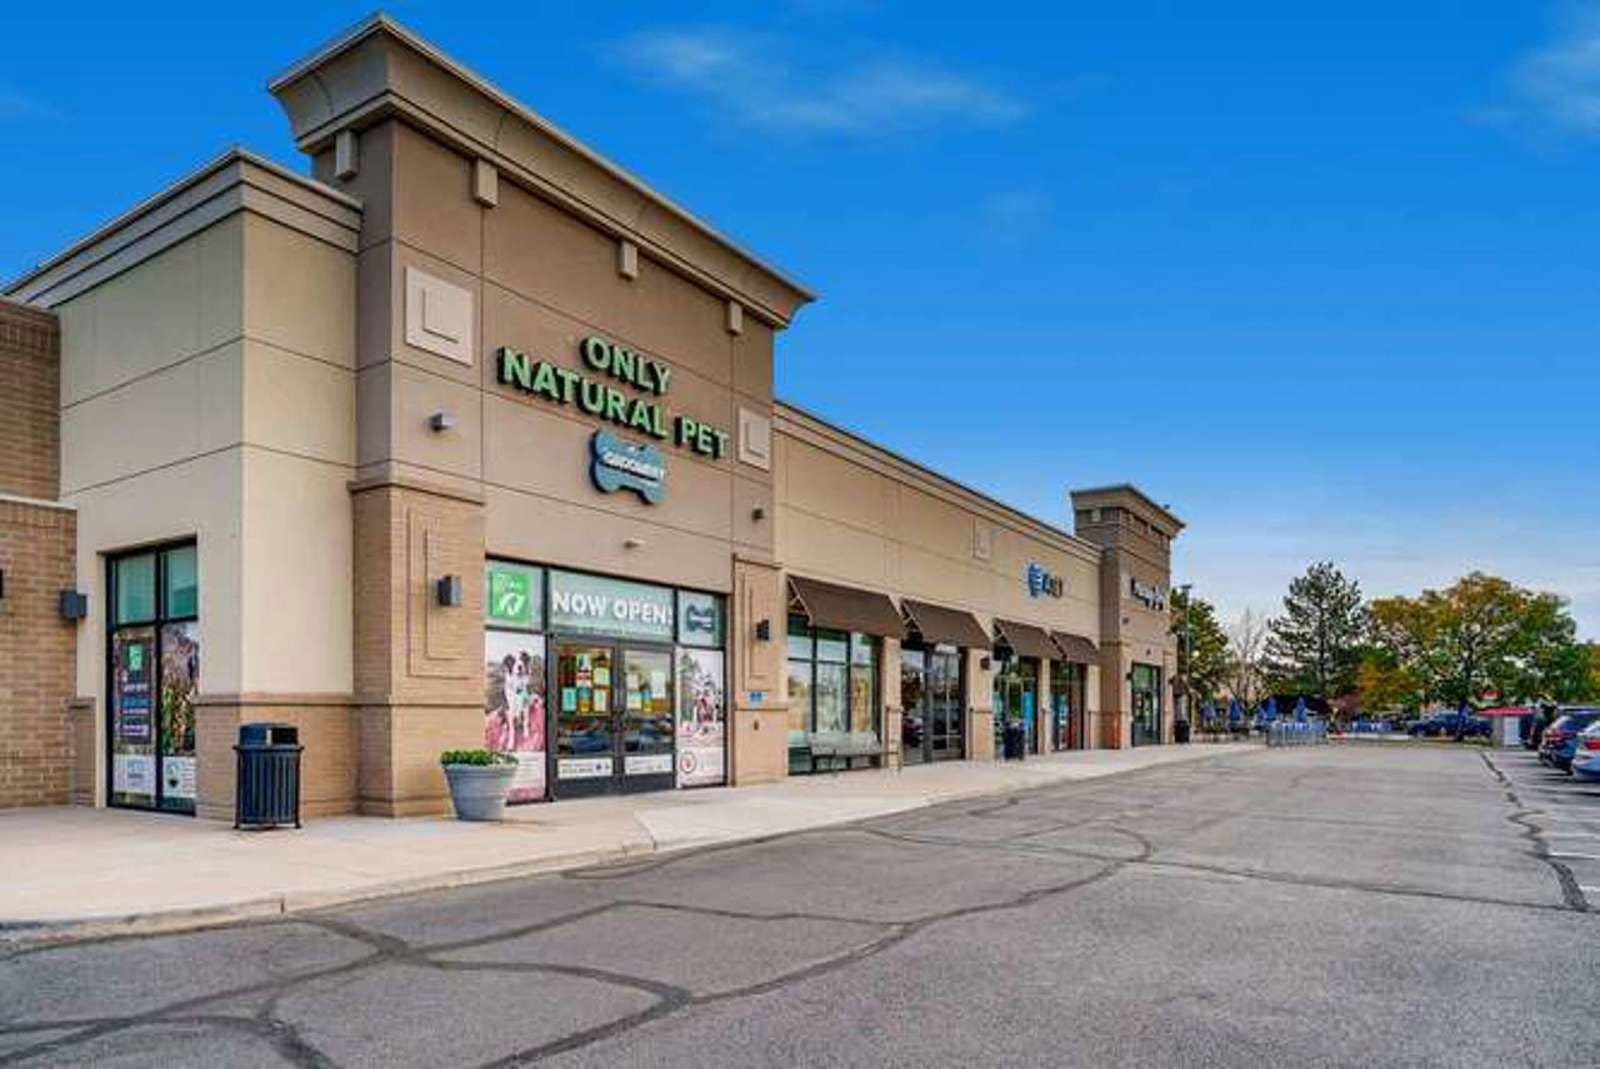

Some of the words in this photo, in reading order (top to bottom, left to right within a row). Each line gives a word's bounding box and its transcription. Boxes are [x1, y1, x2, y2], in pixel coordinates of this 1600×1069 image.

[583, 336, 671, 394] ONLY
[499, 346, 669, 439] NATURAL
[677, 416, 730, 458] PET
[552, 590, 606, 617] NOW
[613, 599, 673, 626] OPEN!
